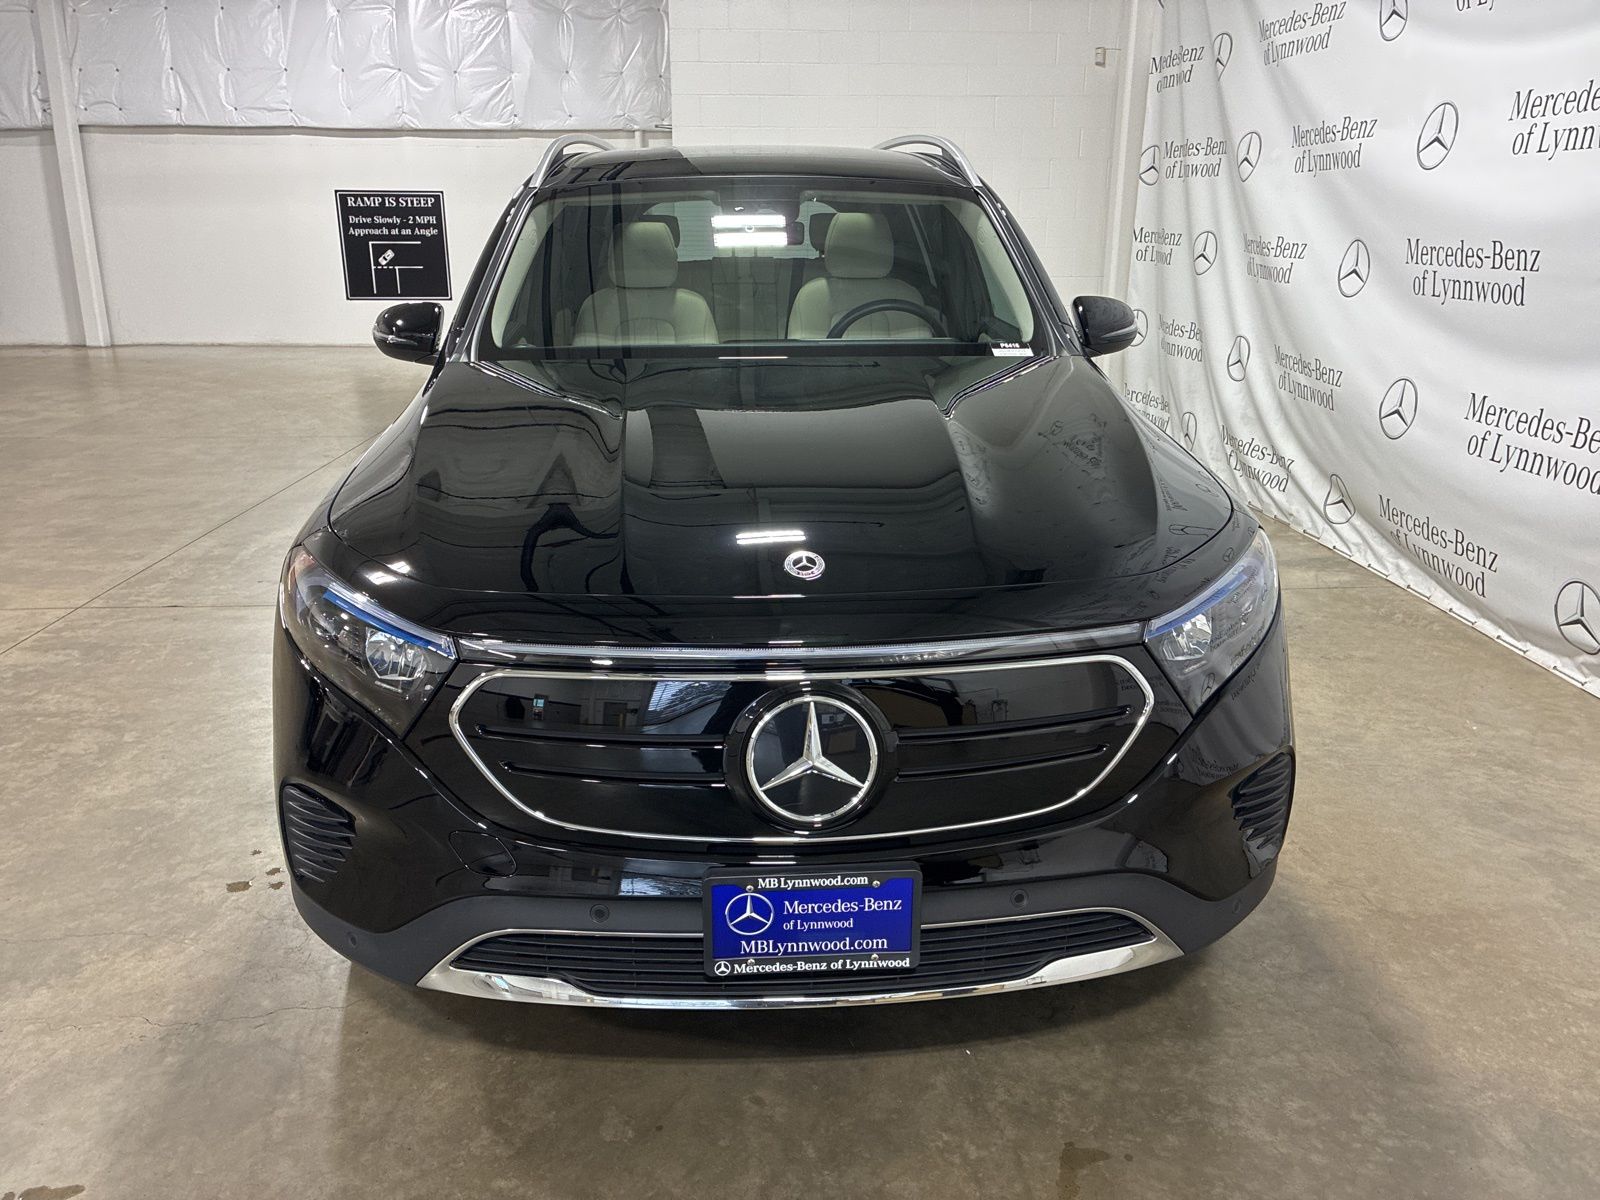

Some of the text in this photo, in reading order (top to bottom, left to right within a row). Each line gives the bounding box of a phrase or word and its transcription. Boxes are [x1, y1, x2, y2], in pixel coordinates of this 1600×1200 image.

[1258, 1, 1347, 43] Mercedes-Benz
[1270, 25, 1333, 68] Lynnwood
[1291, 116, 1378, 148] Mercedes-Benz
[1512, 121, 1600, 161] of Lynn
[1165, 160, 1178, 179] of
[1294, 142, 1363, 178] of Lynnwood
[346, 196, 435, 207] RAMP IS STEEP
[348, 215, 372, 224] Drive
[373, 215, 401, 225] Slowly
[408, 216, 414, 224] 2
[415, 215, 436, 224] MPH
[348, 226, 389, 237] Approach
[390, 227, 399, 235] at
[413, 226, 438, 237] Angle
[1135, 245, 1149, 262] of
[1405, 238, 1541, 273] Mercedes-Benz
[1412, 269, 1525, 307] of Lynnwood
[1274, 343, 1343, 388] Mercedes-Benz
[1278, 370, 1335, 411] of Lynnwood
[1463, 392, 1600, 454] Mercedes-Be
[1467, 430, 1492, 458] of
[1378, 493, 1499, 573] Mercedes-Benz
[1403, 532, 1487, 599] Lynnwood
[783, 897, 902, 915] Mercedes-Benz
[783, 918, 854, 931] of Lynnwood
[740, 937, 888, 956] MBLynnwood.com
[734, 958, 910, 974] Mercedes-Benz of Lynnwood
